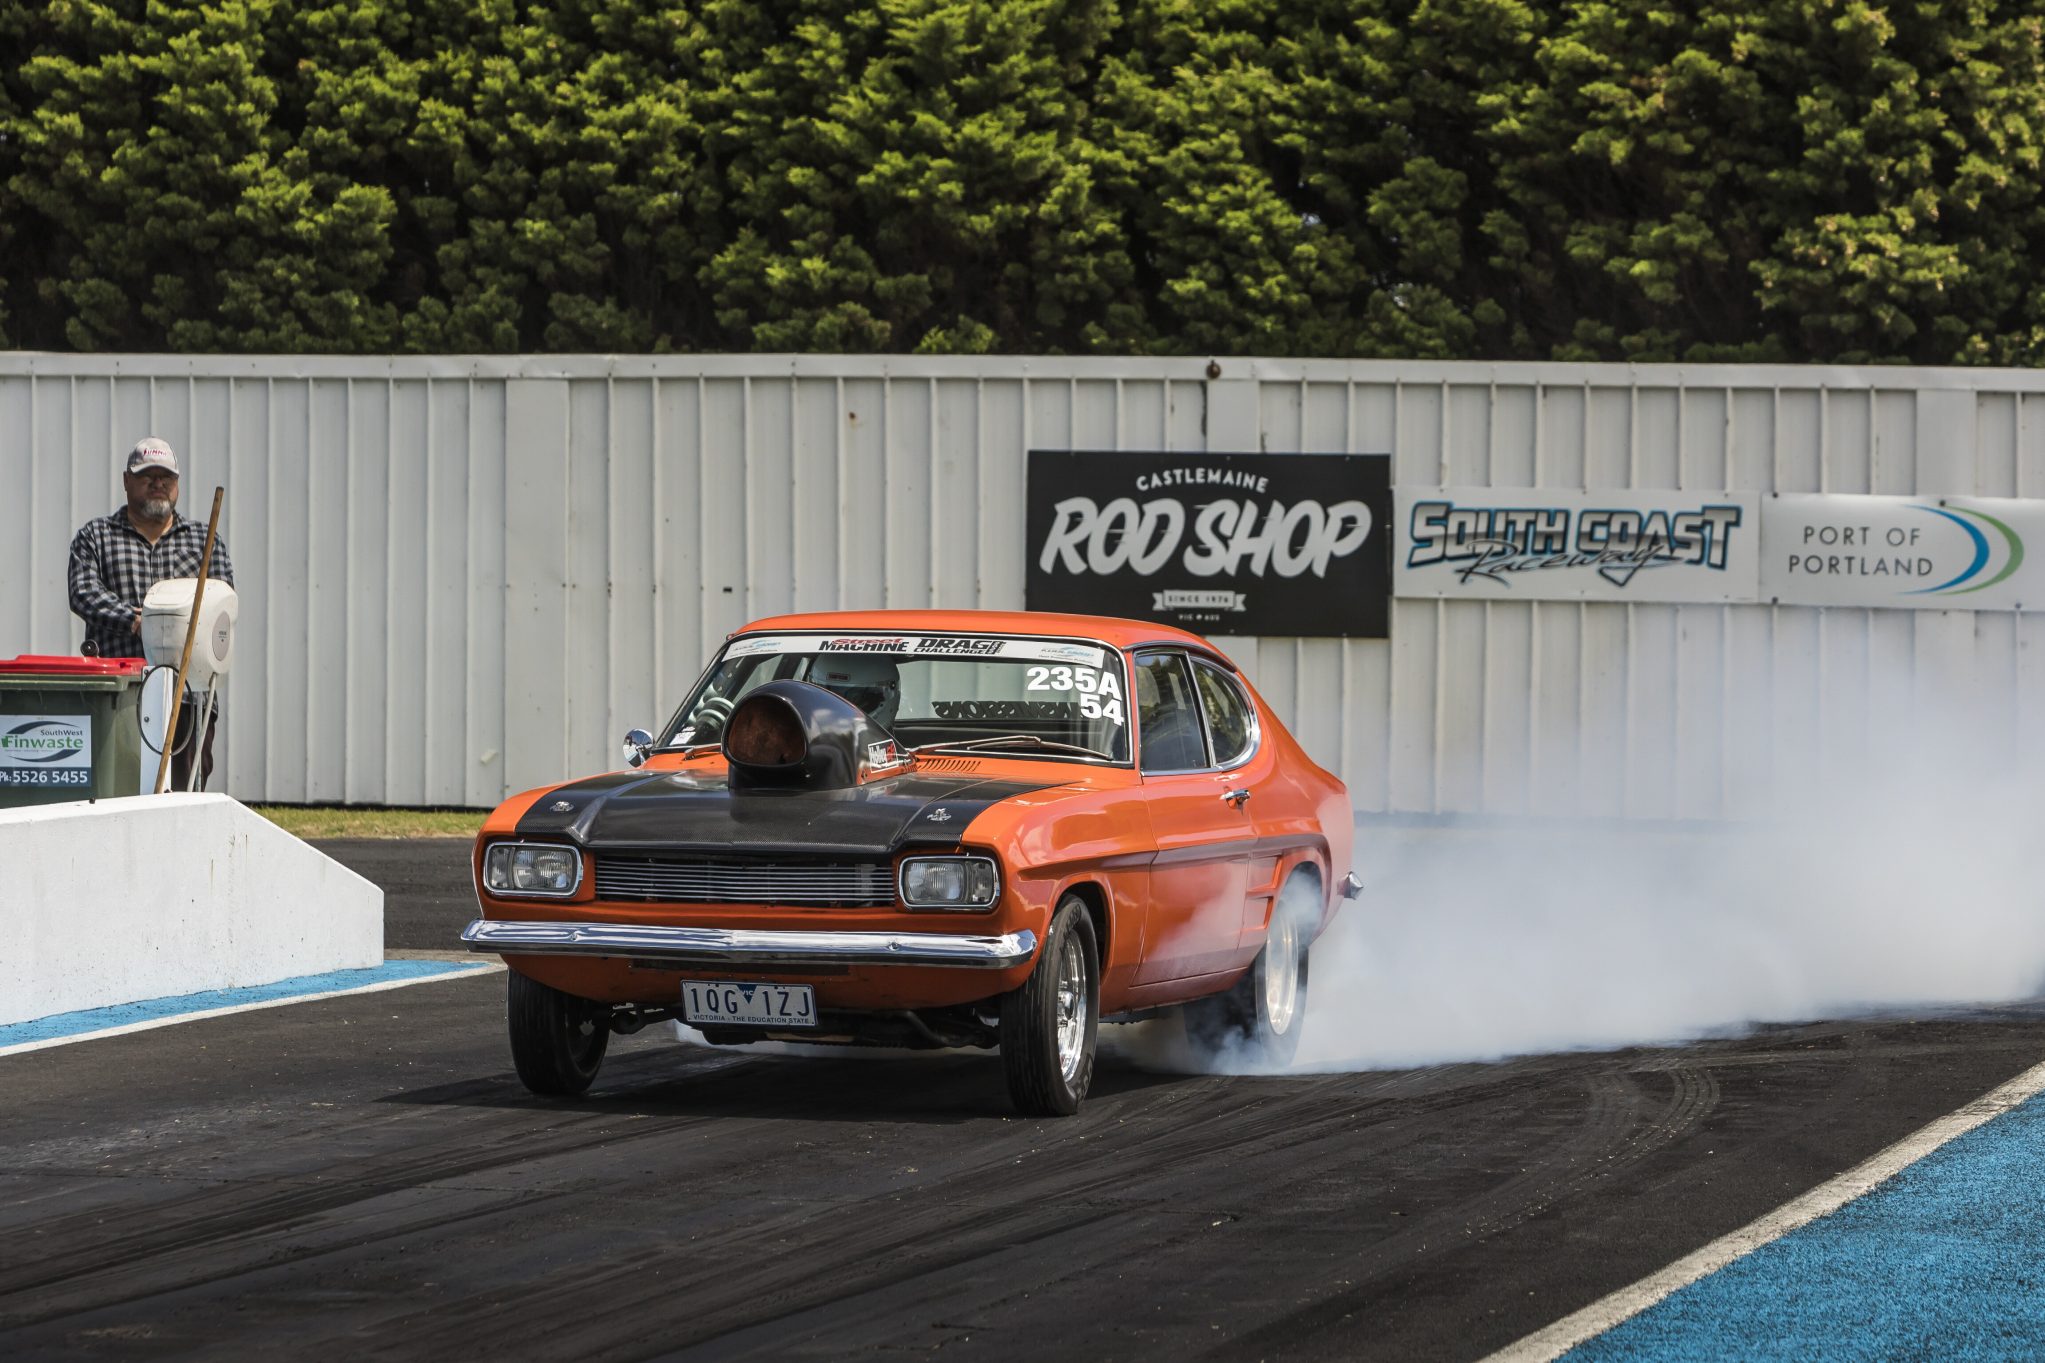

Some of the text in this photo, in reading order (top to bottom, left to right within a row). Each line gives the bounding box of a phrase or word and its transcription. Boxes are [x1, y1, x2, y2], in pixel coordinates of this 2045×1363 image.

[1136, 468, 1269, 493] CASTLEMAINE
[1039, 497, 1372, 578] ROD SHOP
[1406, 500, 1743, 571] SOUTH COAST
[1803, 526, 1921, 547] PORT OF
[1454, 538, 1686, 588] Raceway
[1788, 555, 1933, 577] PORTLAND
[819, 641, 909, 652] MACHINE
[917, 638, 993, 649] DRAG
[1027, 666, 1122, 701] 235A
[1080, 693, 1124, 726] 54
[3, 735, 84, 749] Finwaste
[52, 771, 88, 783] 5455
[690, 987, 810, 1017] 1QG 1ZJ
